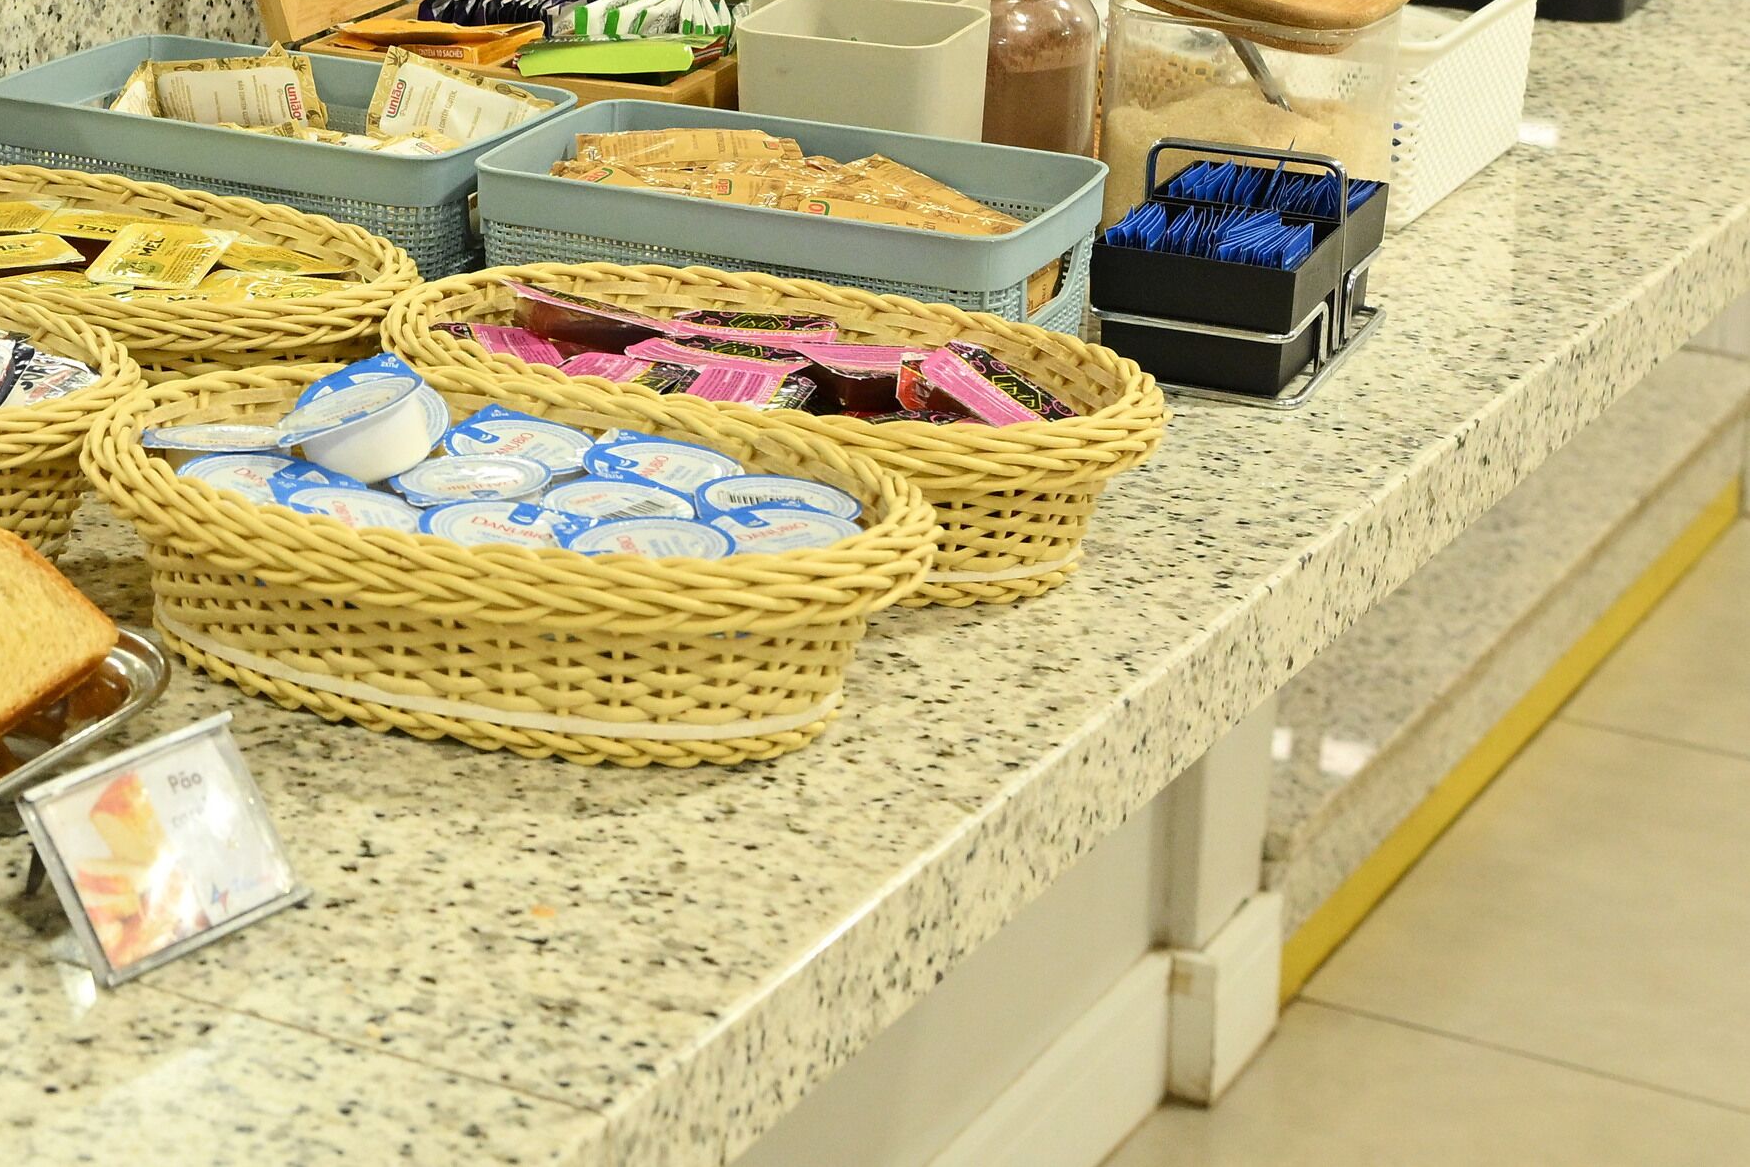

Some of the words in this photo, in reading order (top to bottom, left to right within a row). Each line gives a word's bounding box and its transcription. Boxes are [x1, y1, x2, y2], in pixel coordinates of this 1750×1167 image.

[287, 86, 302, 119] união
[387, 81, 405, 117] união
[140, 236, 165, 258] MEL
[471, 515, 553, 540] DANUBIO
[167, 770, 202, 794] Pão
